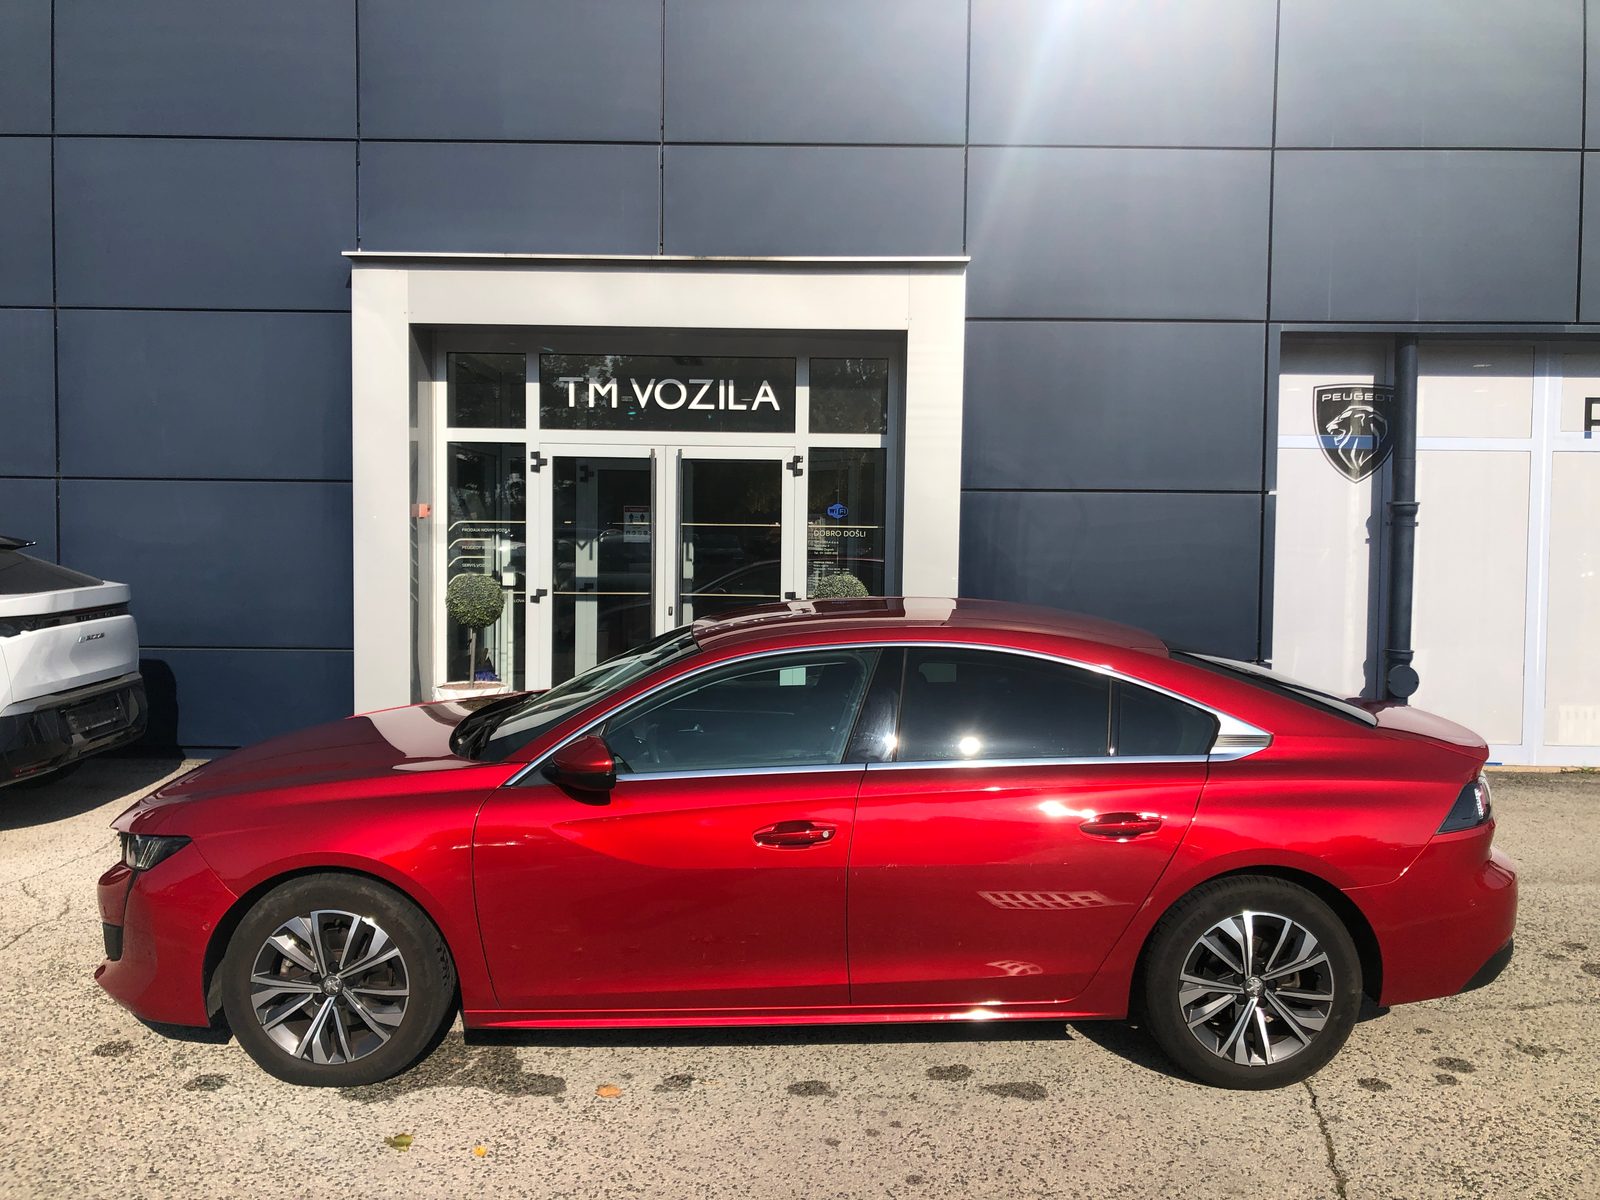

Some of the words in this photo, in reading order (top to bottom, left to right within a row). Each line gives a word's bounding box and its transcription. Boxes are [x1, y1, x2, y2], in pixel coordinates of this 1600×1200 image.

[558, 376, 619, 409] TM
[629, 378, 782, 411] VOZILA
[1321, 392, 1395, 402] PEUGEOT
